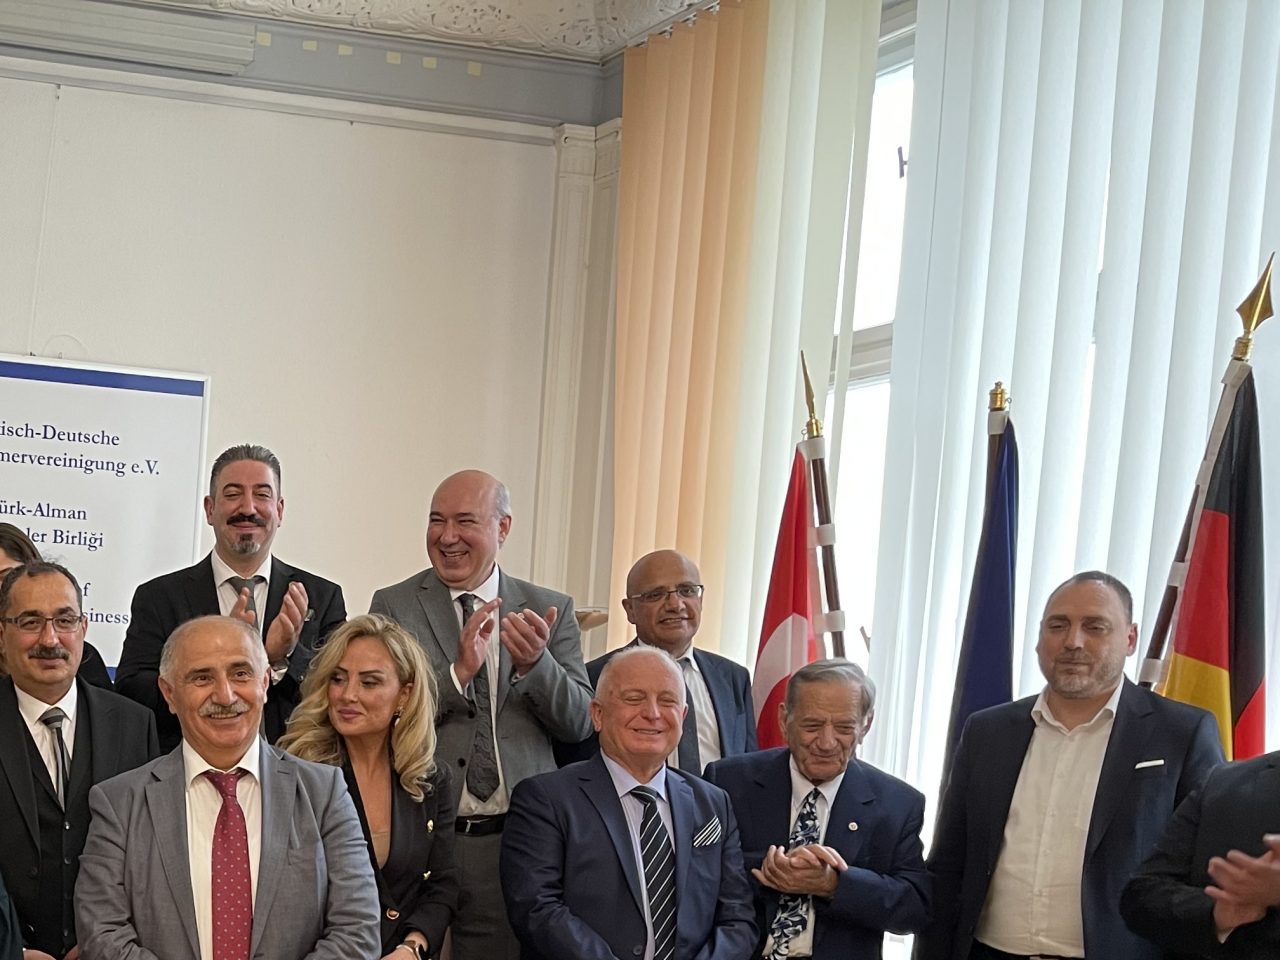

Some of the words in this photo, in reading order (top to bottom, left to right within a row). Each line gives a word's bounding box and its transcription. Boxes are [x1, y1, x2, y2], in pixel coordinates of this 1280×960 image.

[131, 459, 160, 475] e.V.
[53, 529, 104, 551] Birliği
[82, 608, 129, 624] iness
